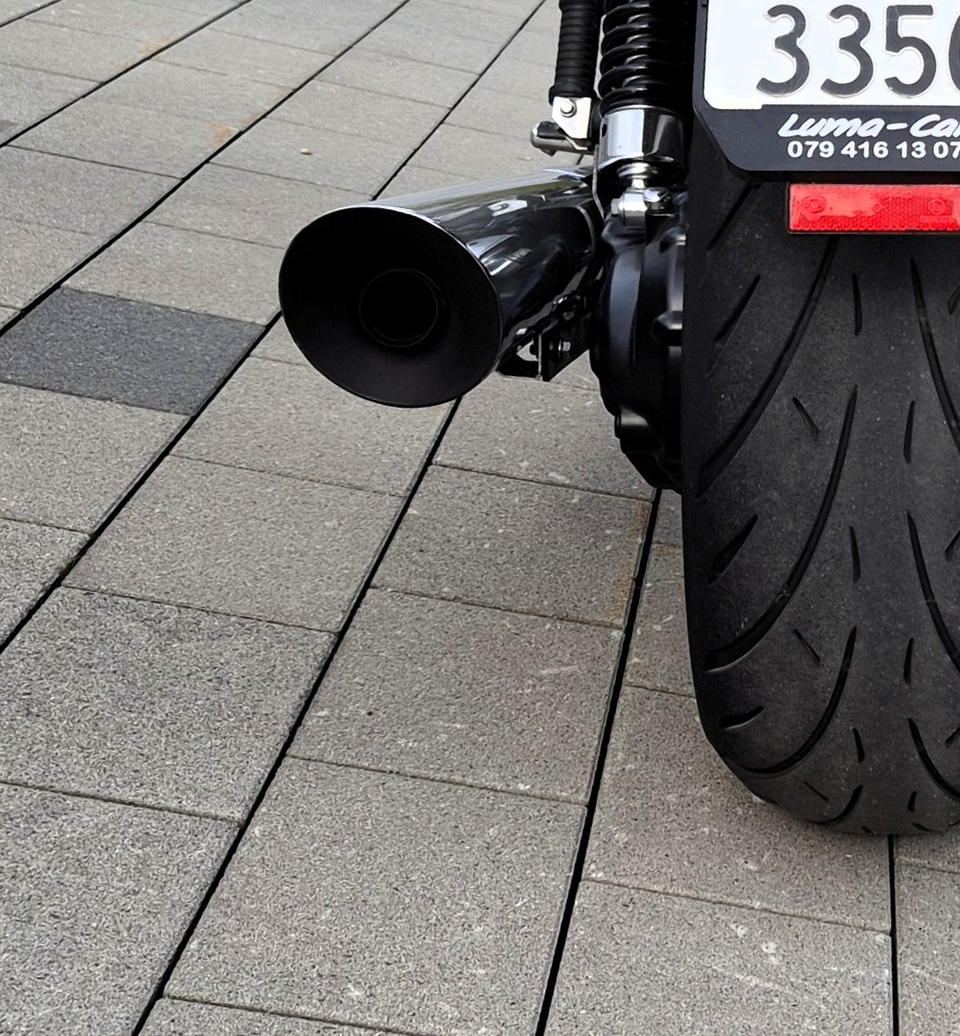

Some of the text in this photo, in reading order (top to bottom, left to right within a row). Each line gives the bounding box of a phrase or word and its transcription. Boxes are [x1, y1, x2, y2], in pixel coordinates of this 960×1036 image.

[787, 140, 835, 159] 079
[840, 140, 889, 159] 416
[896, 140, 927, 159] 13
